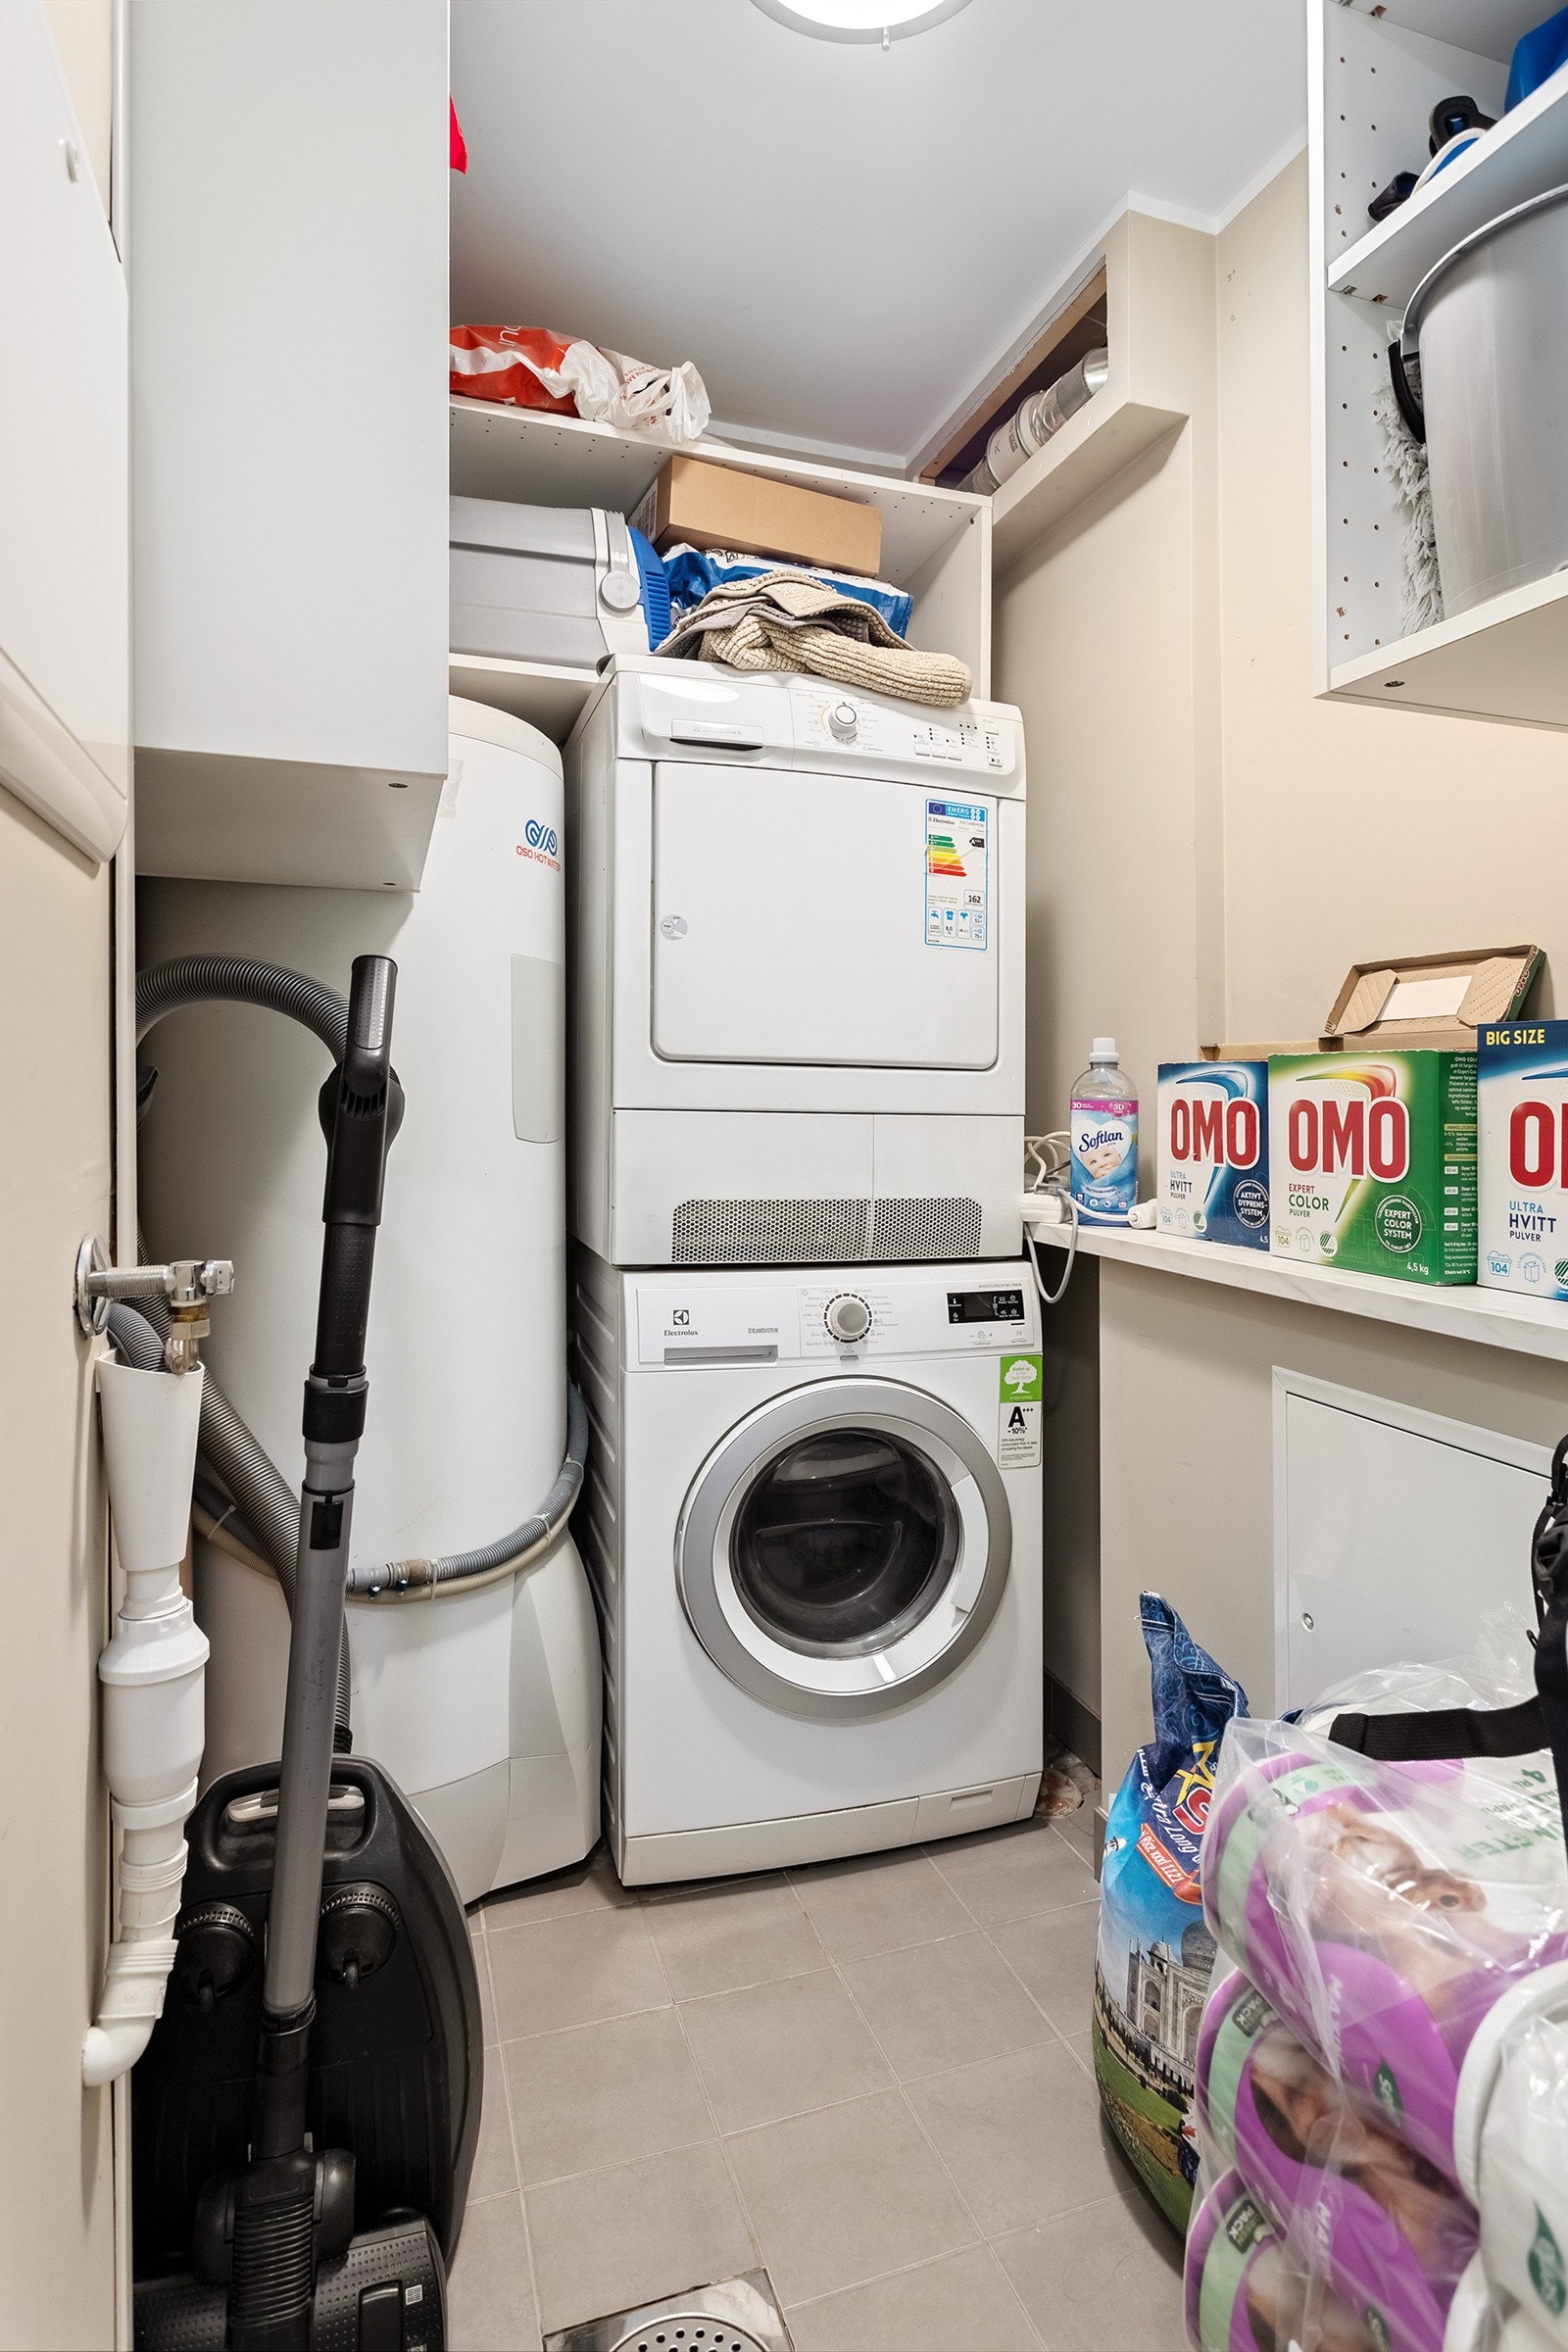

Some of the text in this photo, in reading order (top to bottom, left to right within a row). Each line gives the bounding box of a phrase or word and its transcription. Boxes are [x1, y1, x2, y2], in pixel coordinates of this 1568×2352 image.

[515, 845, 534, 859] OSO
[968, 895, 981, 904] 162
[1486, 1029, 1545, 1046] BIG SIZE
[1170, 1099, 1257, 1167] OMO
[1289, 1100, 1406, 1179] OMO
[1079, 1130, 1124, 1152] Softlan
[1170, 1179, 1193, 1193] HVITT
[1289, 1183, 1315, 1194] EXPERT
[1289, 1194, 1329, 1210] COLOR
[1509, 1200, 1544, 1213] ULTRA
[1241, 1207, 1263, 1216] SYSTEM
[1289, 1208, 1311, 1217] PULVER
[1384, 1209, 1412, 1219] EXPERT
[1384, 1219, 1412, 1230] COLOR
[1510, 1213, 1556, 1233] HVITT
[1277, 1235, 1290, 1245] 104
[1384, 1228, 1412, 1240] SYSTEM
[1510, 1231, 1542, 1242] PULVER
[1406, 1261, 1429, 1275] 4,5 kg
[1491, 1262, 1508, 1273] 104
[1165, 1823, 1197, 1853] Long
[1140, 1836, 1153, 1853] Rice
[1161, 1862, 1184, 1884] 1121
[1228, 2205, 1255, 2240] PACK
